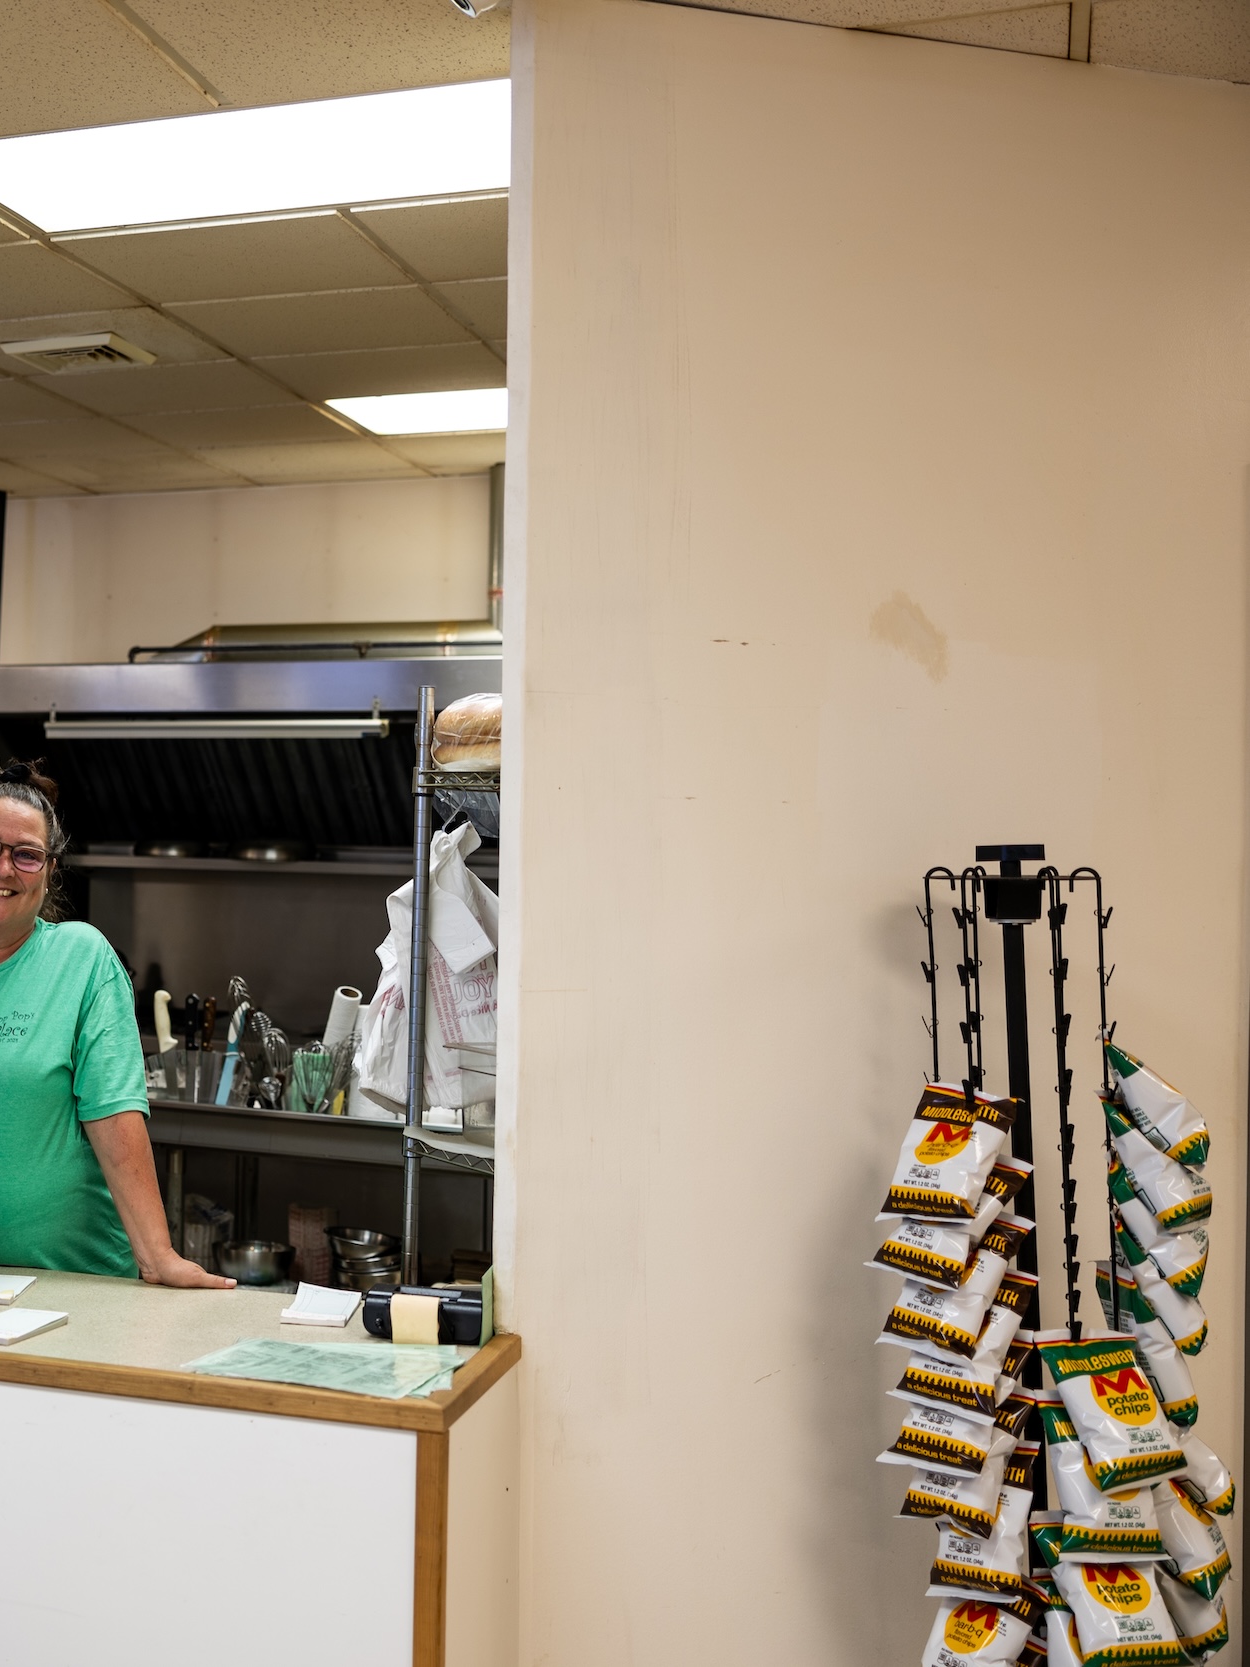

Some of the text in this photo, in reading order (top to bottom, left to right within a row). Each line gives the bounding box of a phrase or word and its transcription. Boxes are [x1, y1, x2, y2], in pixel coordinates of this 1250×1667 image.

[889, 1255, 921, 1271] delicious
[921, 1266, 942, 1278] treat
[914, 1383, 951, 1400] delicious
[952, 1393, 978, 1407] treat
[1107, 1392, 1148, 1408] potato
[1114, 1403, 1151, 1416] chips
[903, 1443, 938, 1458] delicious
[939, 1452, 962, 1465] treat
[1097, 1583, 1140, 1595] potato
[1104, 1594, 1142, 1605] chips
